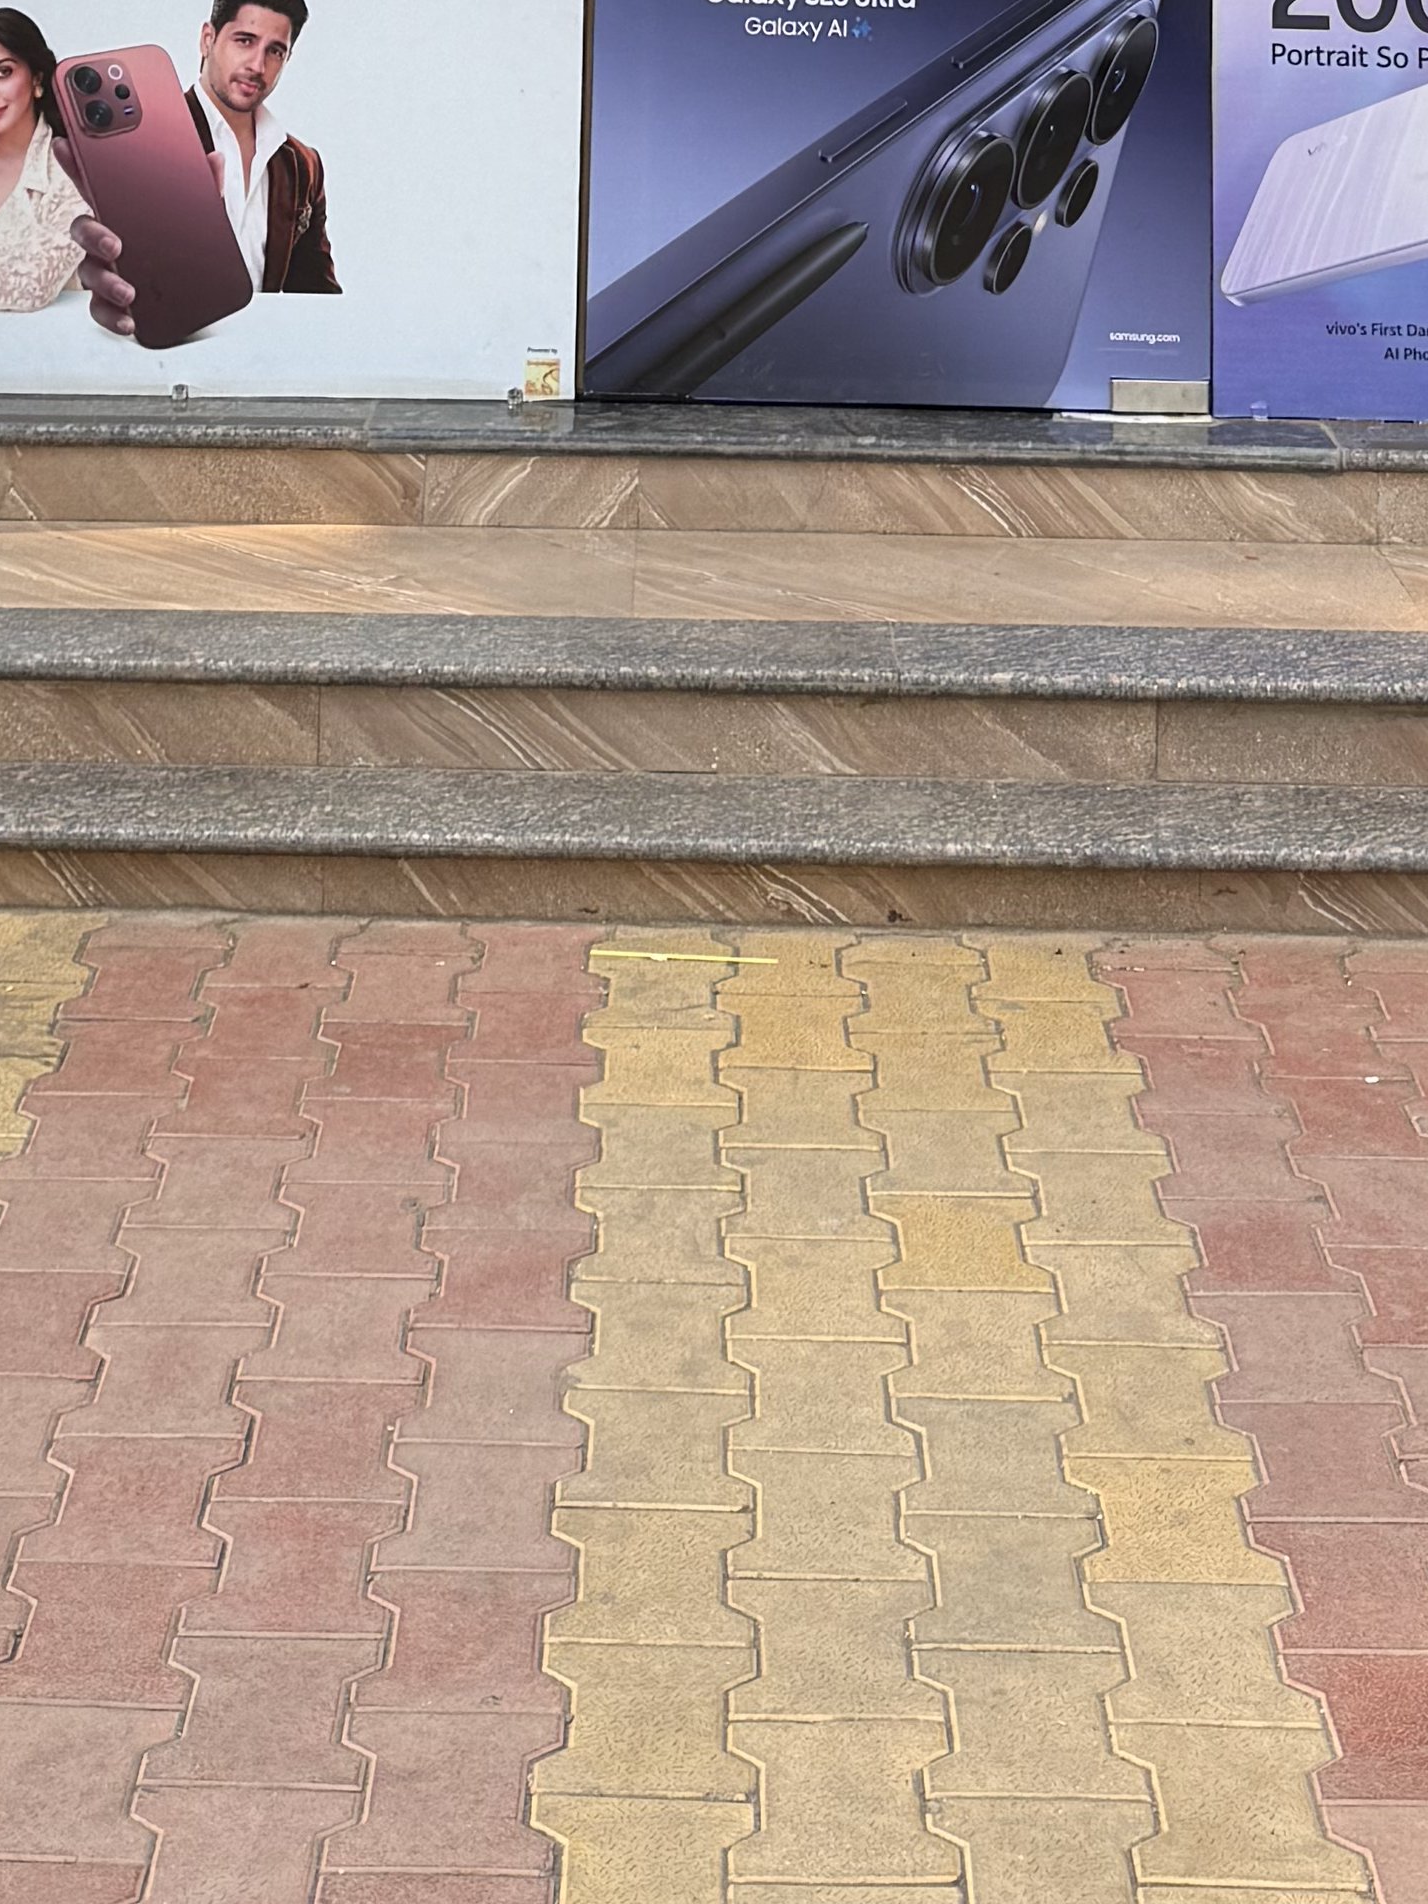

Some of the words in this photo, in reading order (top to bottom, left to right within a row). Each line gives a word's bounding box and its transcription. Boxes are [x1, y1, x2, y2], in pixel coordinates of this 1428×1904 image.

[744, 17, 823, 42] Galaxy
[828, 19, 847, 38] AI
[1271, 43, 1368, 68] Portrait
[1376, 46, 1408, 69] So
[1110, 332, 1180, 344] samsung.com
[1326, 322, 1367, 337] vivo's
[1371, 323, 1402, 338] First
[1384, 347, 1401, 361] AI
